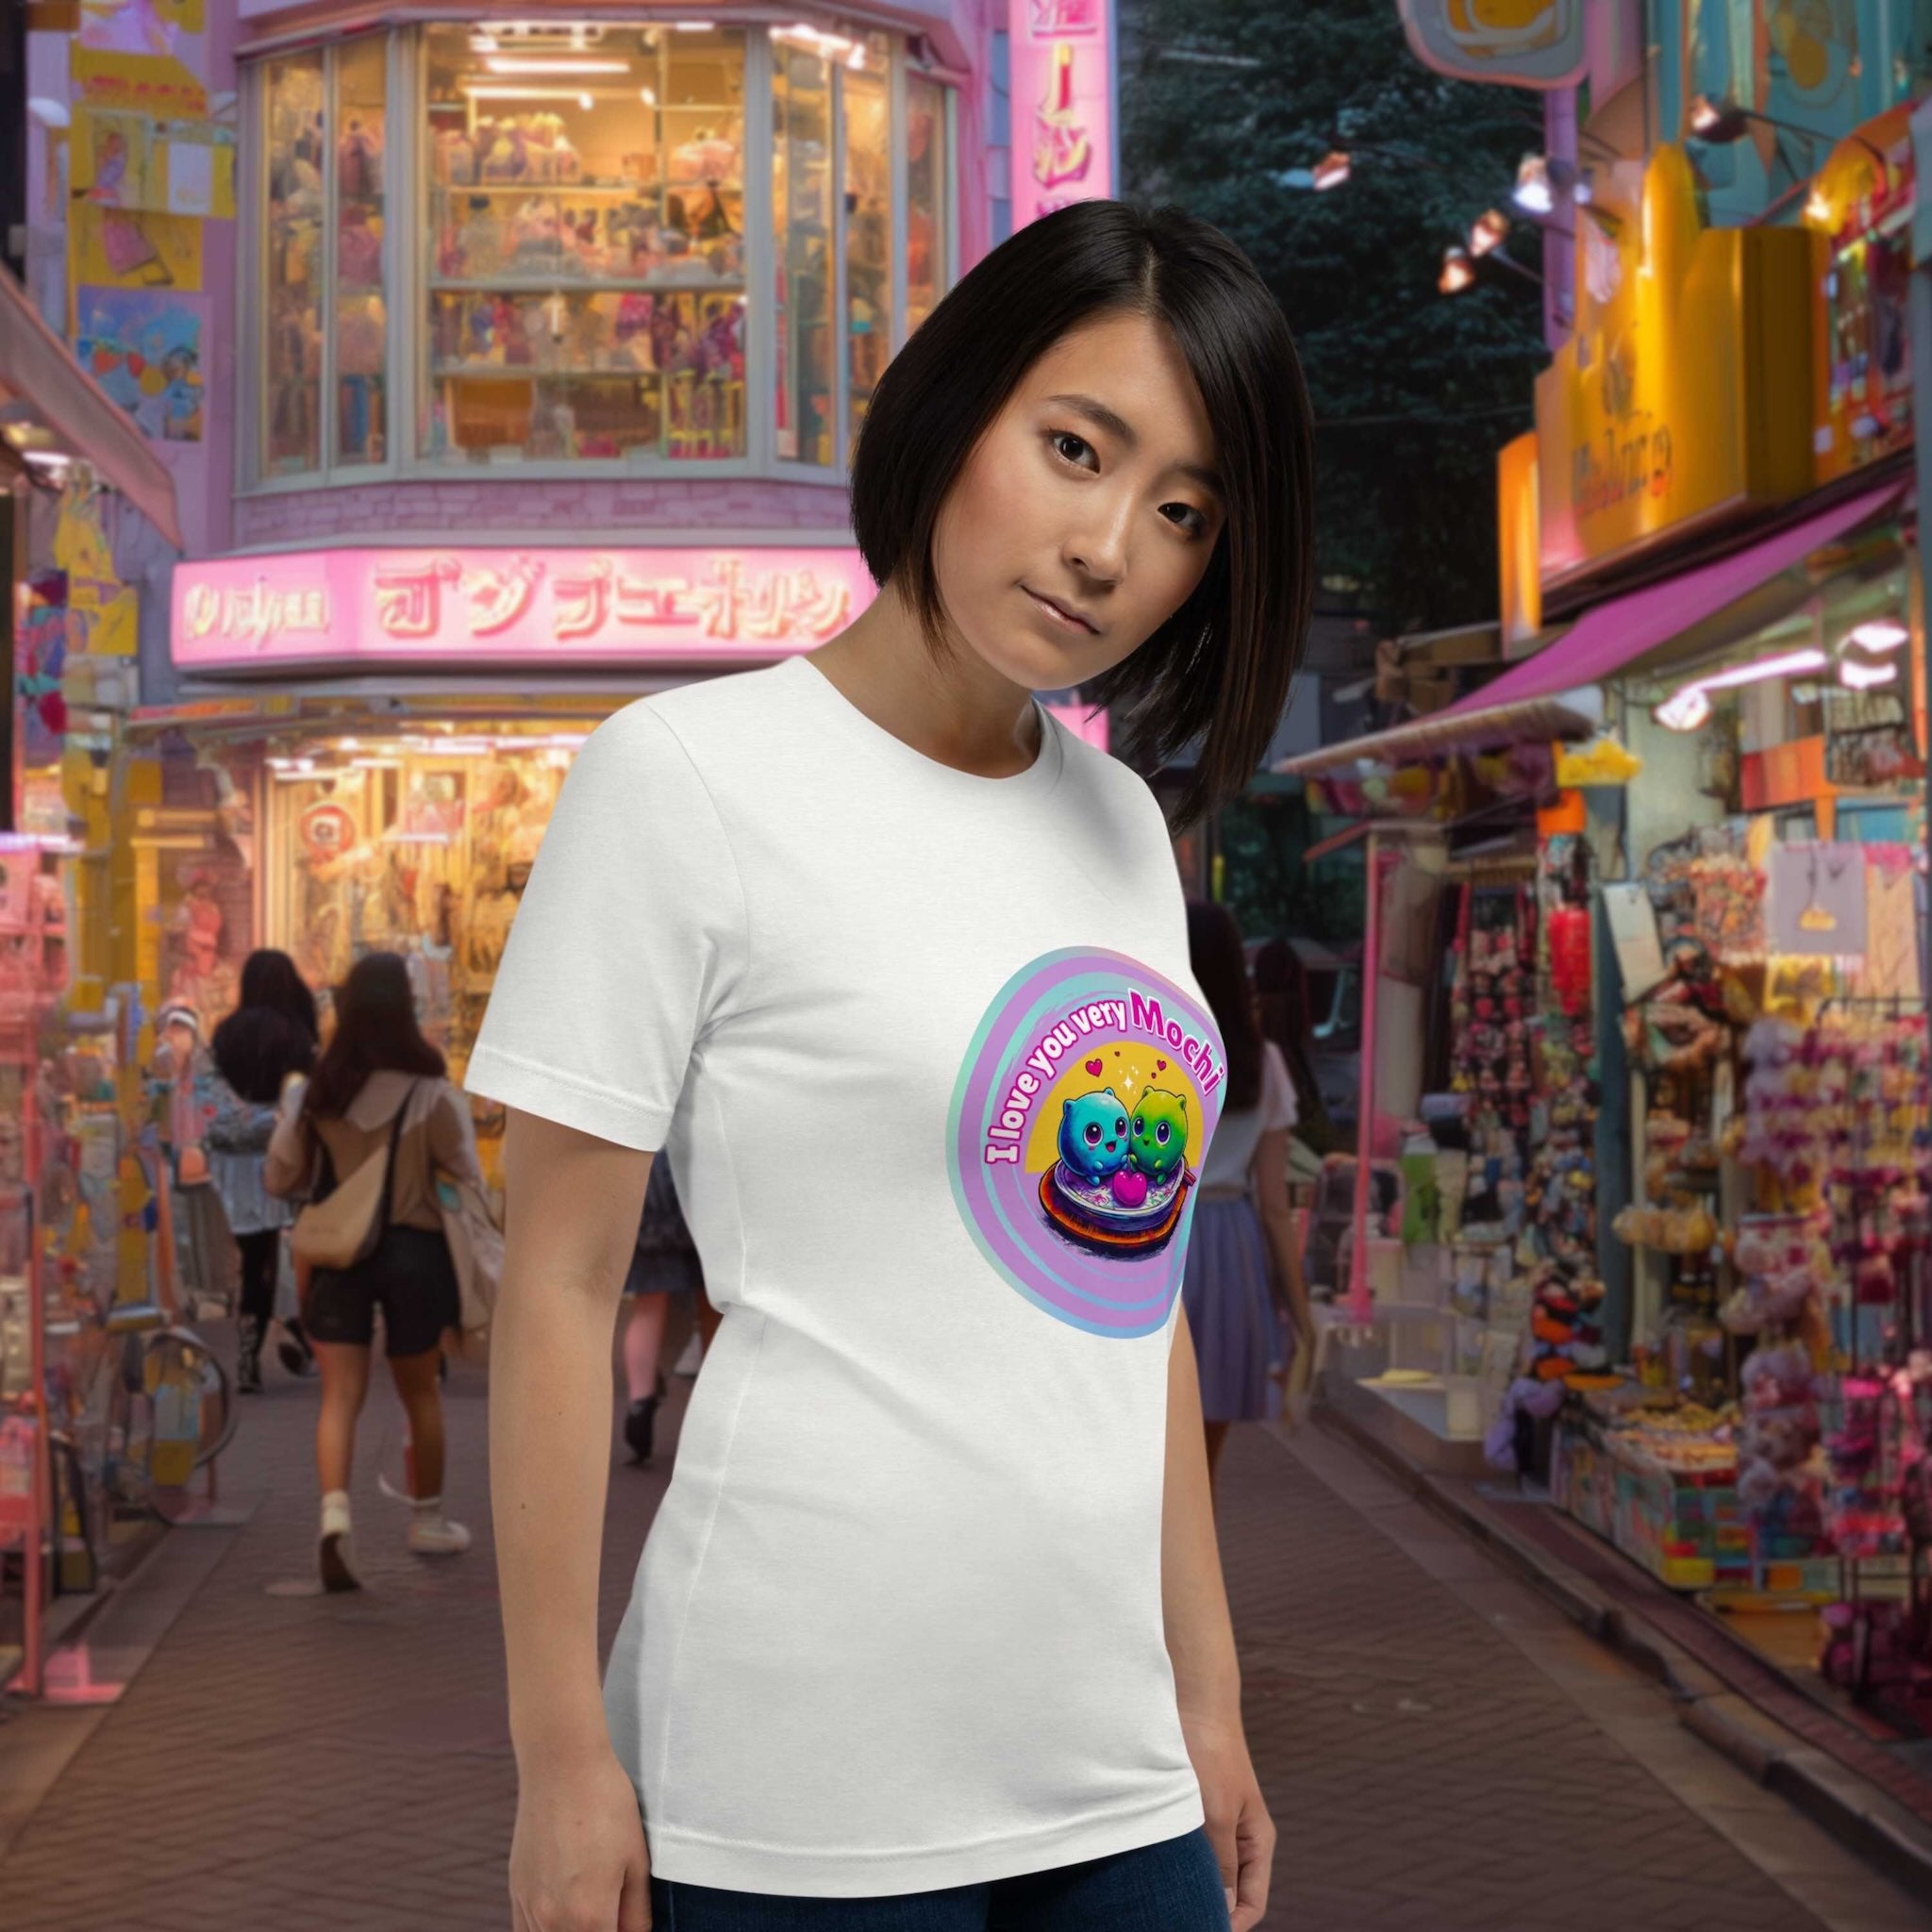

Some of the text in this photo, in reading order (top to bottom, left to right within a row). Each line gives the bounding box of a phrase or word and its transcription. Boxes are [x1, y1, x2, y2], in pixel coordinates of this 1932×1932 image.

[985, 989, 1225, 1165] I love you very Mochi
